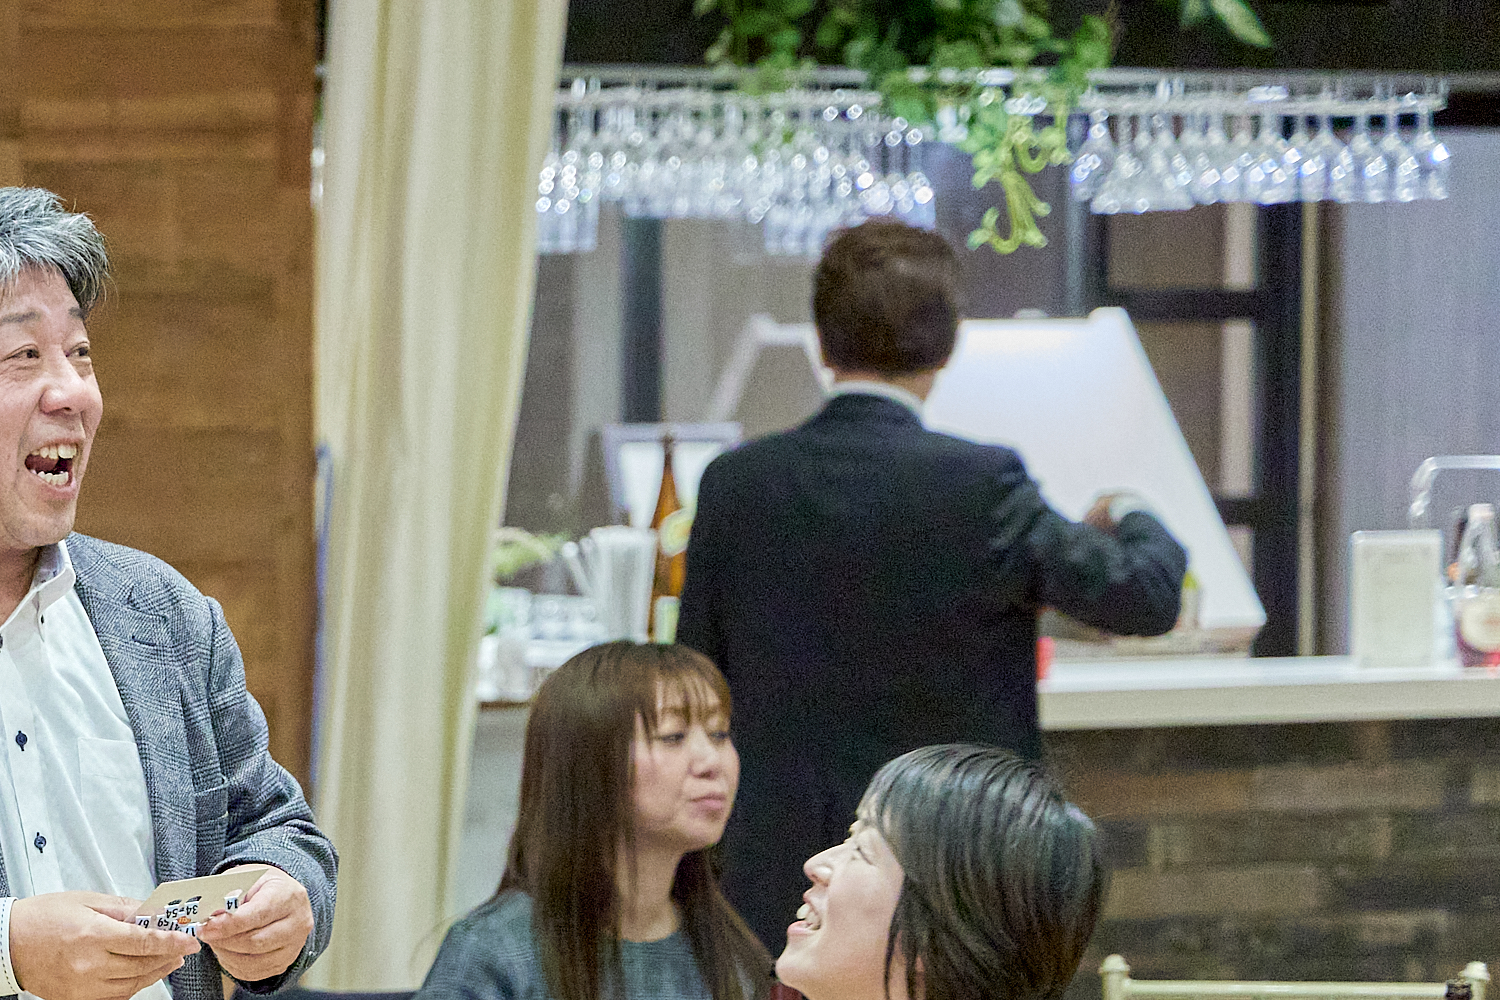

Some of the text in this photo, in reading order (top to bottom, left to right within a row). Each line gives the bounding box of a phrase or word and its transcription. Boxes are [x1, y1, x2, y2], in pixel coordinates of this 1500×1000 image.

[185, 904, 198, 915] 34
[226, 899, 239, 910] 14
[165, 908, 179, 918] 54
